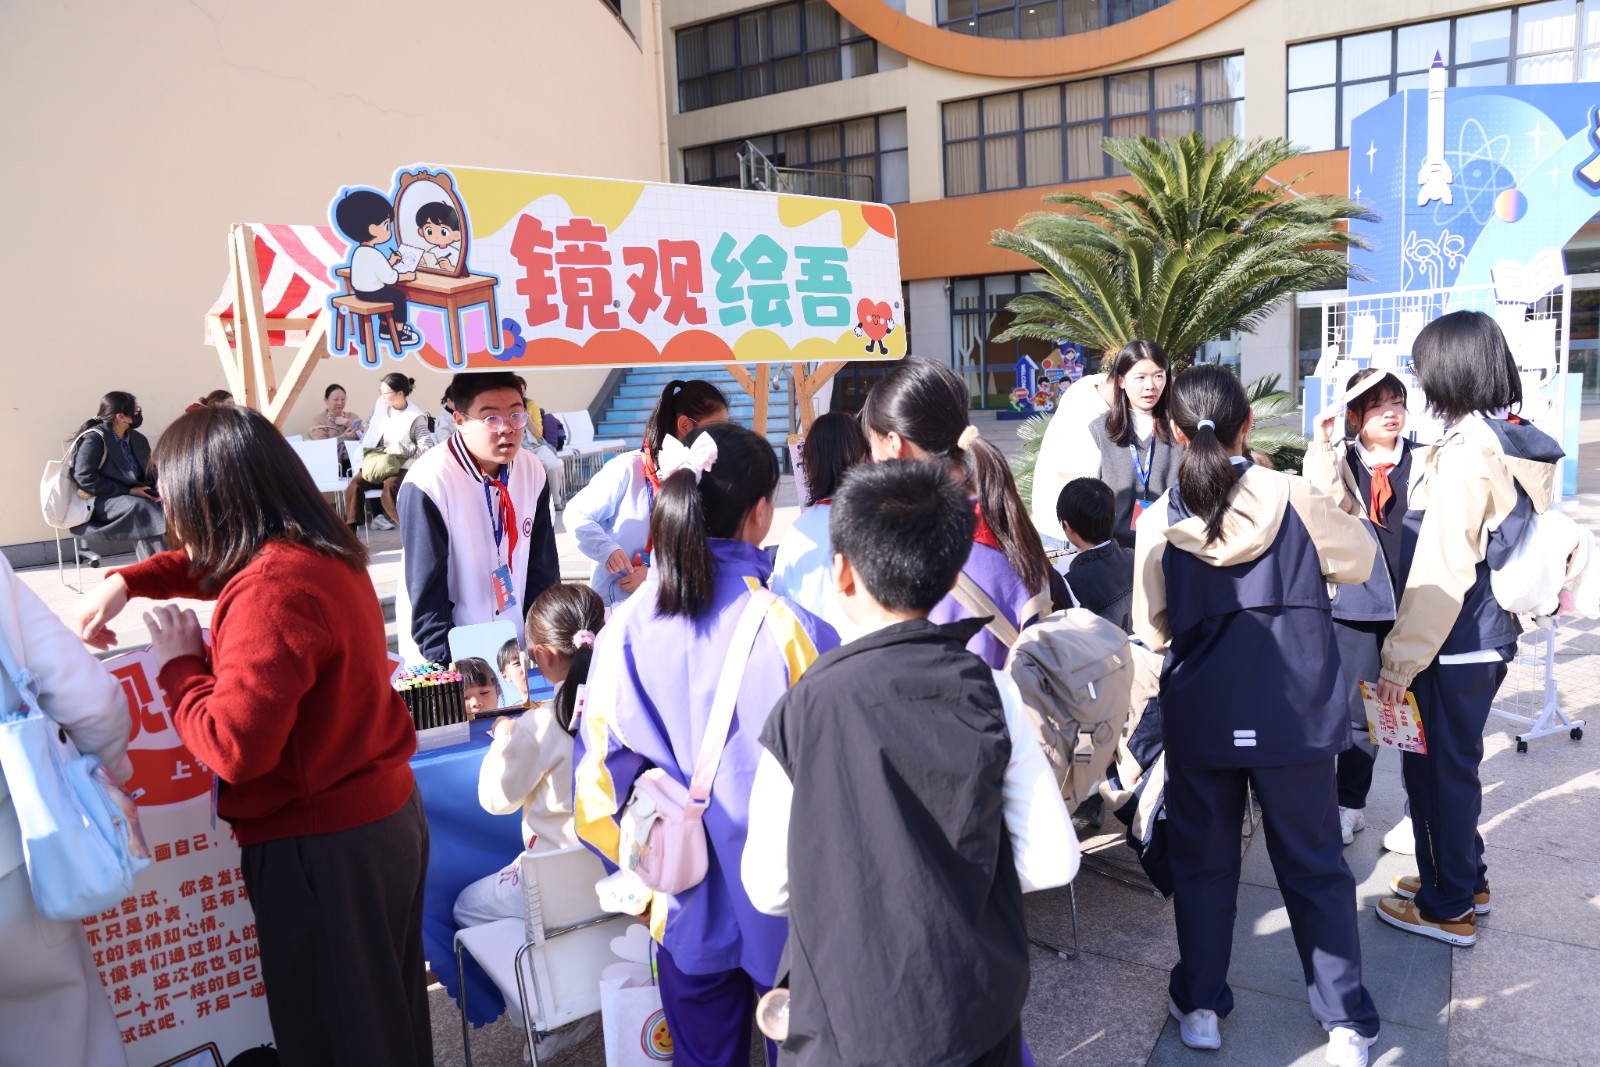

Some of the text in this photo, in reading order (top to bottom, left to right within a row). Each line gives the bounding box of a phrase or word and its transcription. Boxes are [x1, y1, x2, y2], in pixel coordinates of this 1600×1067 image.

[509, 213, 854, 331] 镜观绘吾
[107, 943, 260, 1004] 样，这次你也可以
[115, 964, 260, 1018] 一个不一样的自己
